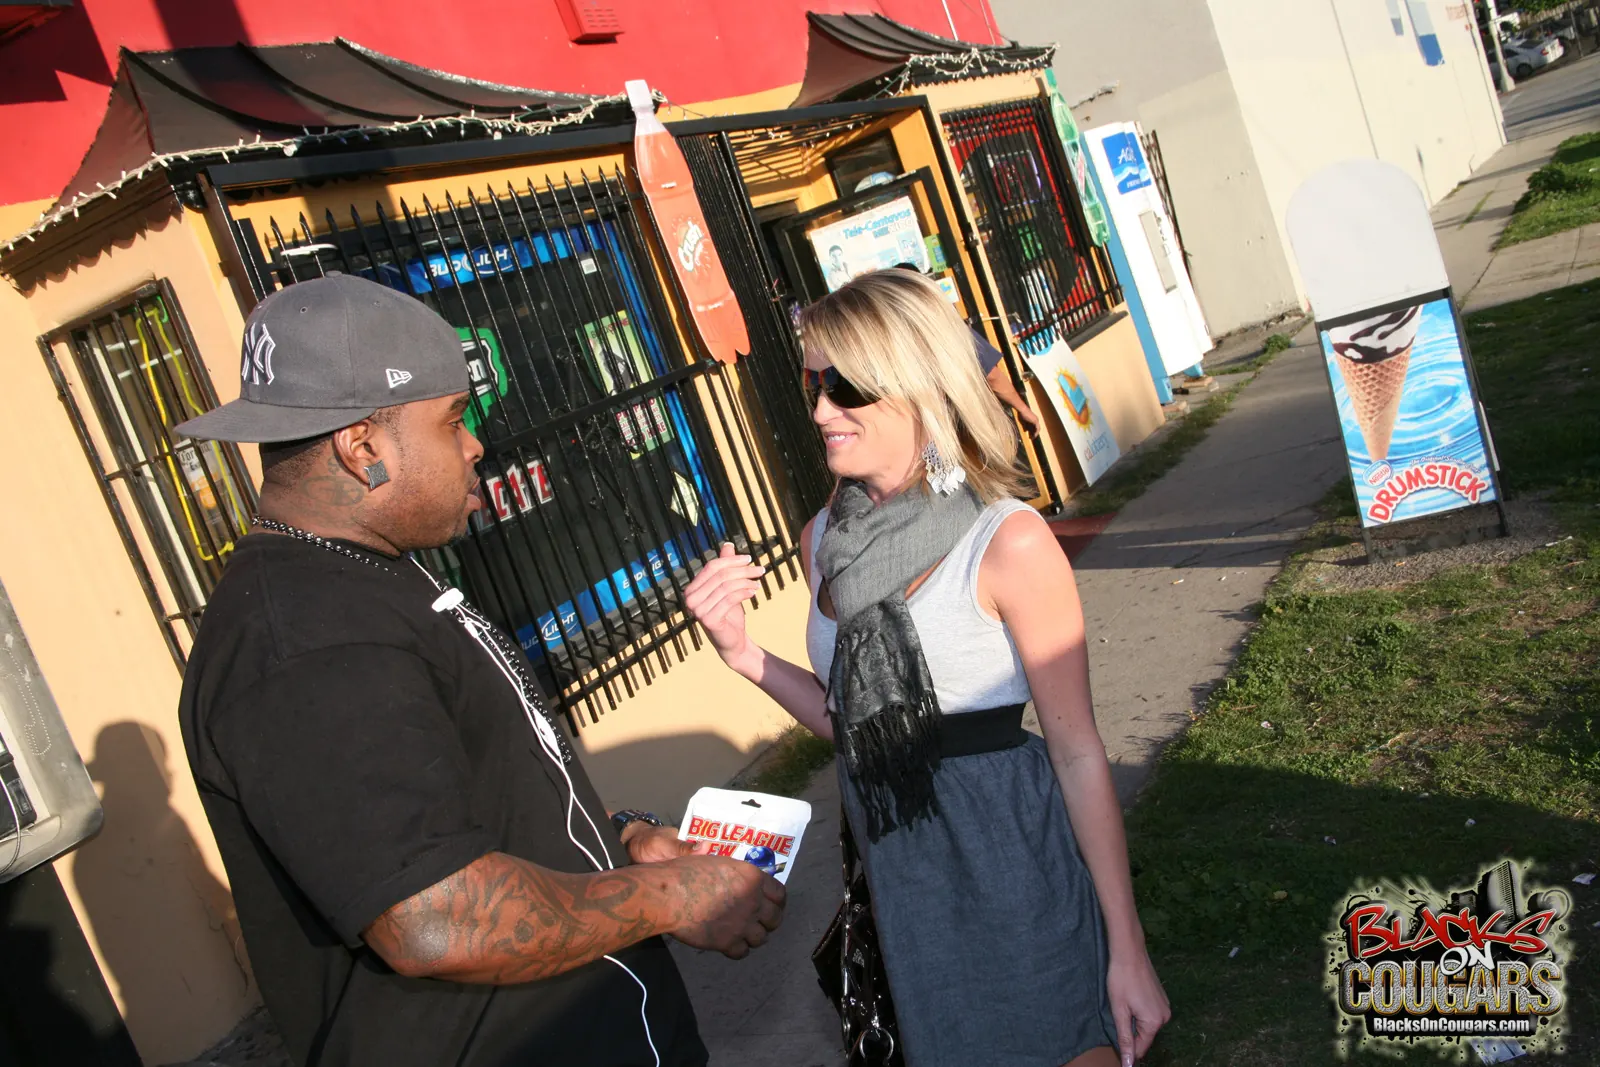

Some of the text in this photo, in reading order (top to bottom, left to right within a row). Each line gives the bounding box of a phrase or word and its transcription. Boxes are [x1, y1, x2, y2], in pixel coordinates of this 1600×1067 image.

[843, 208, 911, 239] Tele-Centavos
[474, 248, 511, 269] LIGH
[677, 220, 703, 272] Crush
[470, 460, 555, 530] ECATE
[1368, 463, 1487, 522] DRUMSTICK
[622, 552, 673, 590] BD IGT
[687, 815, 796, 857] BIG LEAGUE
